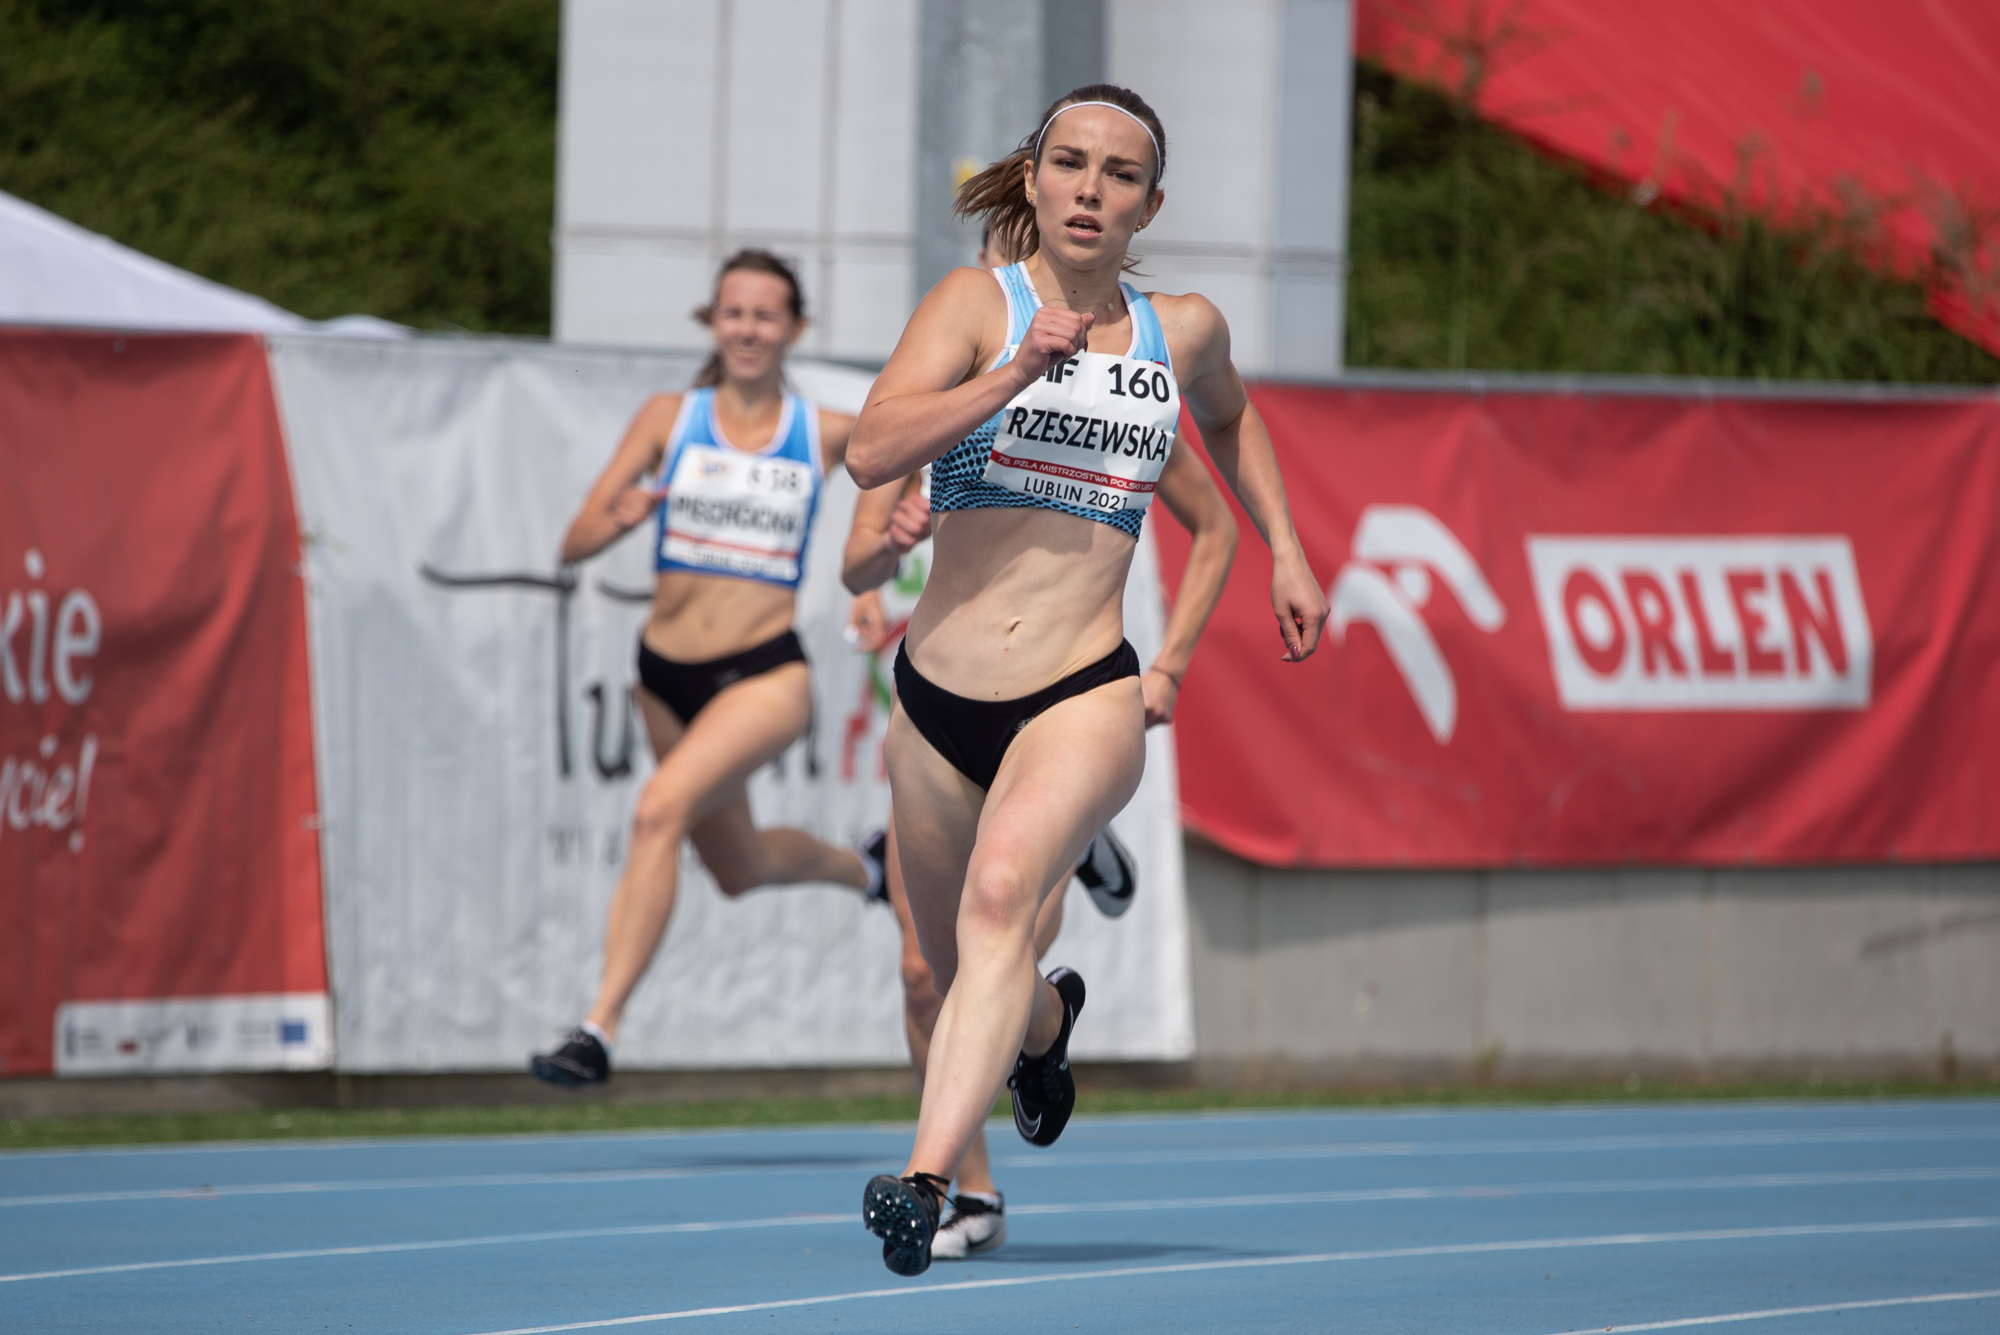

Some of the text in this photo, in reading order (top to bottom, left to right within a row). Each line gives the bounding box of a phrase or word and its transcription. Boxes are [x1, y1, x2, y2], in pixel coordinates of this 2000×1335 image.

[1107, 363, 1170, 403] 160
[1006, 406, 1168, 462] RZESZEWSKA
[1013, 459, 1038, 470] PZLA
[1039, 463, 1109, 485] MISTRZOSTWA
[1109, 477, 1141, 491] POLSKI
[1023, 476, 1128, 511] LUBLIN 2021
[1560, 563, 1850, 684] ORLEN
